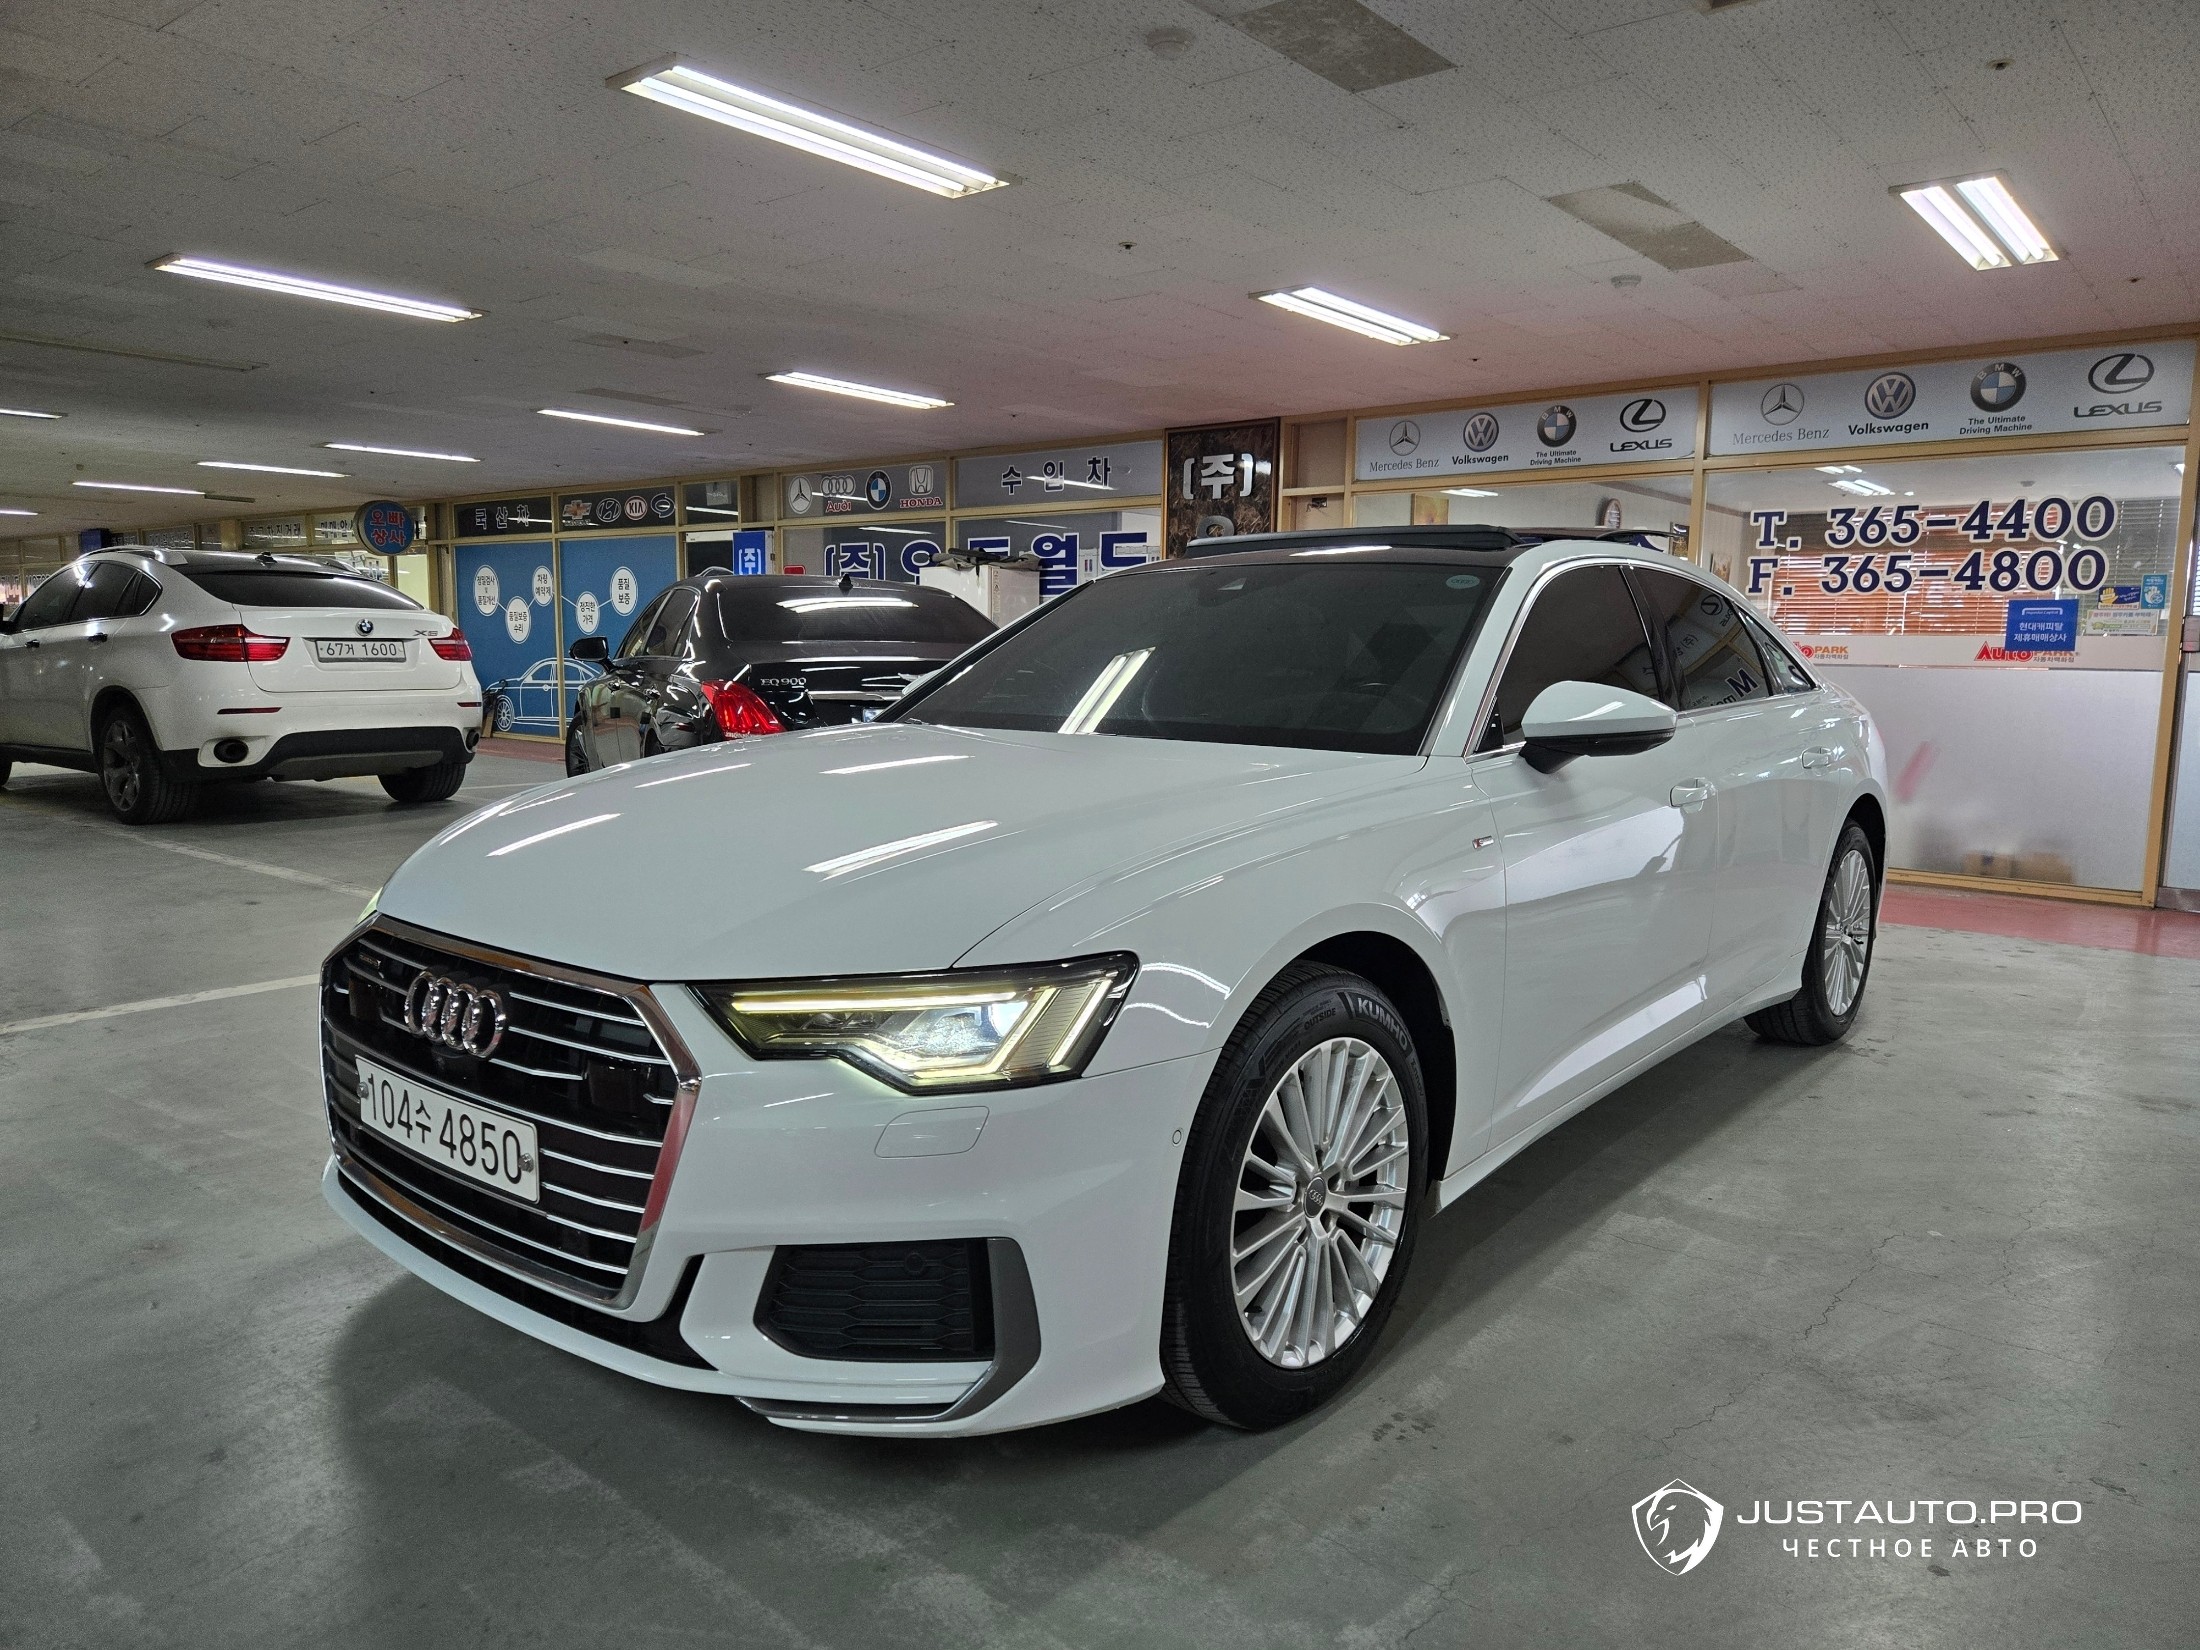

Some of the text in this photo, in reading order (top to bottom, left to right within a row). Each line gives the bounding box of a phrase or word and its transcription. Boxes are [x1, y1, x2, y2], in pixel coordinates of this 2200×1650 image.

[2073, 401, 2163, 418] LEXUS
[1968, 415, 2026, 426] The Ultimate
[1848, 422, 1929, 436] Volkswagen
[1959, 423, 2033, 435] Driving Machine
[1732, 428, 1830, 446] Mercedes Benz
[1610, 439, 1673, 452] LEXUS
[1369, 458, 1440, 473] Mercedes Benz
[1452, 454, 1509, 465] Volkswagen
[629, 501, 643, 513] KIA
[826, 501, 852, 513] Audi
[900, 497, 943, 509] HONDA
[369, 510, 405, 528] 오빠
[1752, 496, 2116, 549] T. 365-4400
[371, 527, 406, 548] 상사
[1747, 549, 2107, 597] F. 365-4800
[617, 578, 631, 590] 품질
[618, 593, 631, 606] 보증
[2019, 622, 2064, 632] 현대캐피탈
[2013, 632, 2067, 643] 제휴매매상사
[326, 642, 397, 656] 67거 1600
[1814, 645, 1849, 654] PARK
[1303, 1007, 1337, 1031] OUTSIDE
[1357, 997, 1408, 1050] KUMHO
[367, 1073, 523, 1185] 104수 4850
